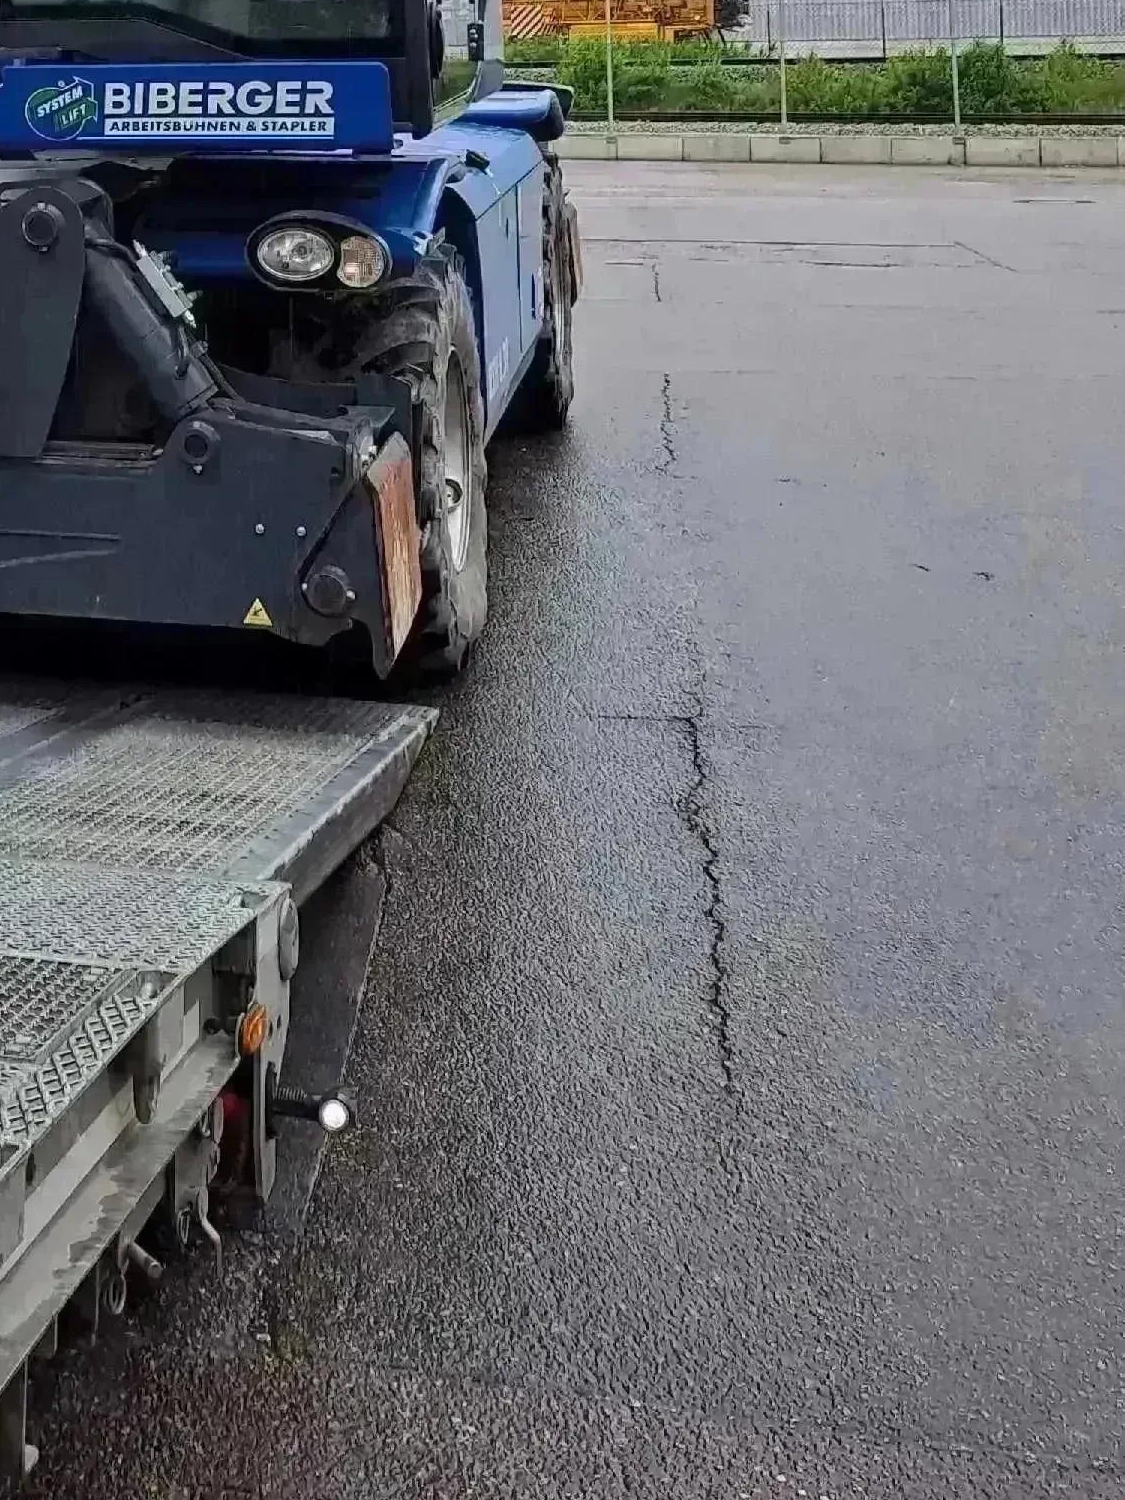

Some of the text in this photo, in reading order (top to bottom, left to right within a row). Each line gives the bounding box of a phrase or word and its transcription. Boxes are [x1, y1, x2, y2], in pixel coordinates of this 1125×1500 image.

[37, 85, 83, 118] SYSTEM
[104, 80, 334, 115] BIBERGER
[61, 103, 86, 125] LIFT
[246, 120, 257, 132] &
[260, 120, 327, 132] STAPLER
